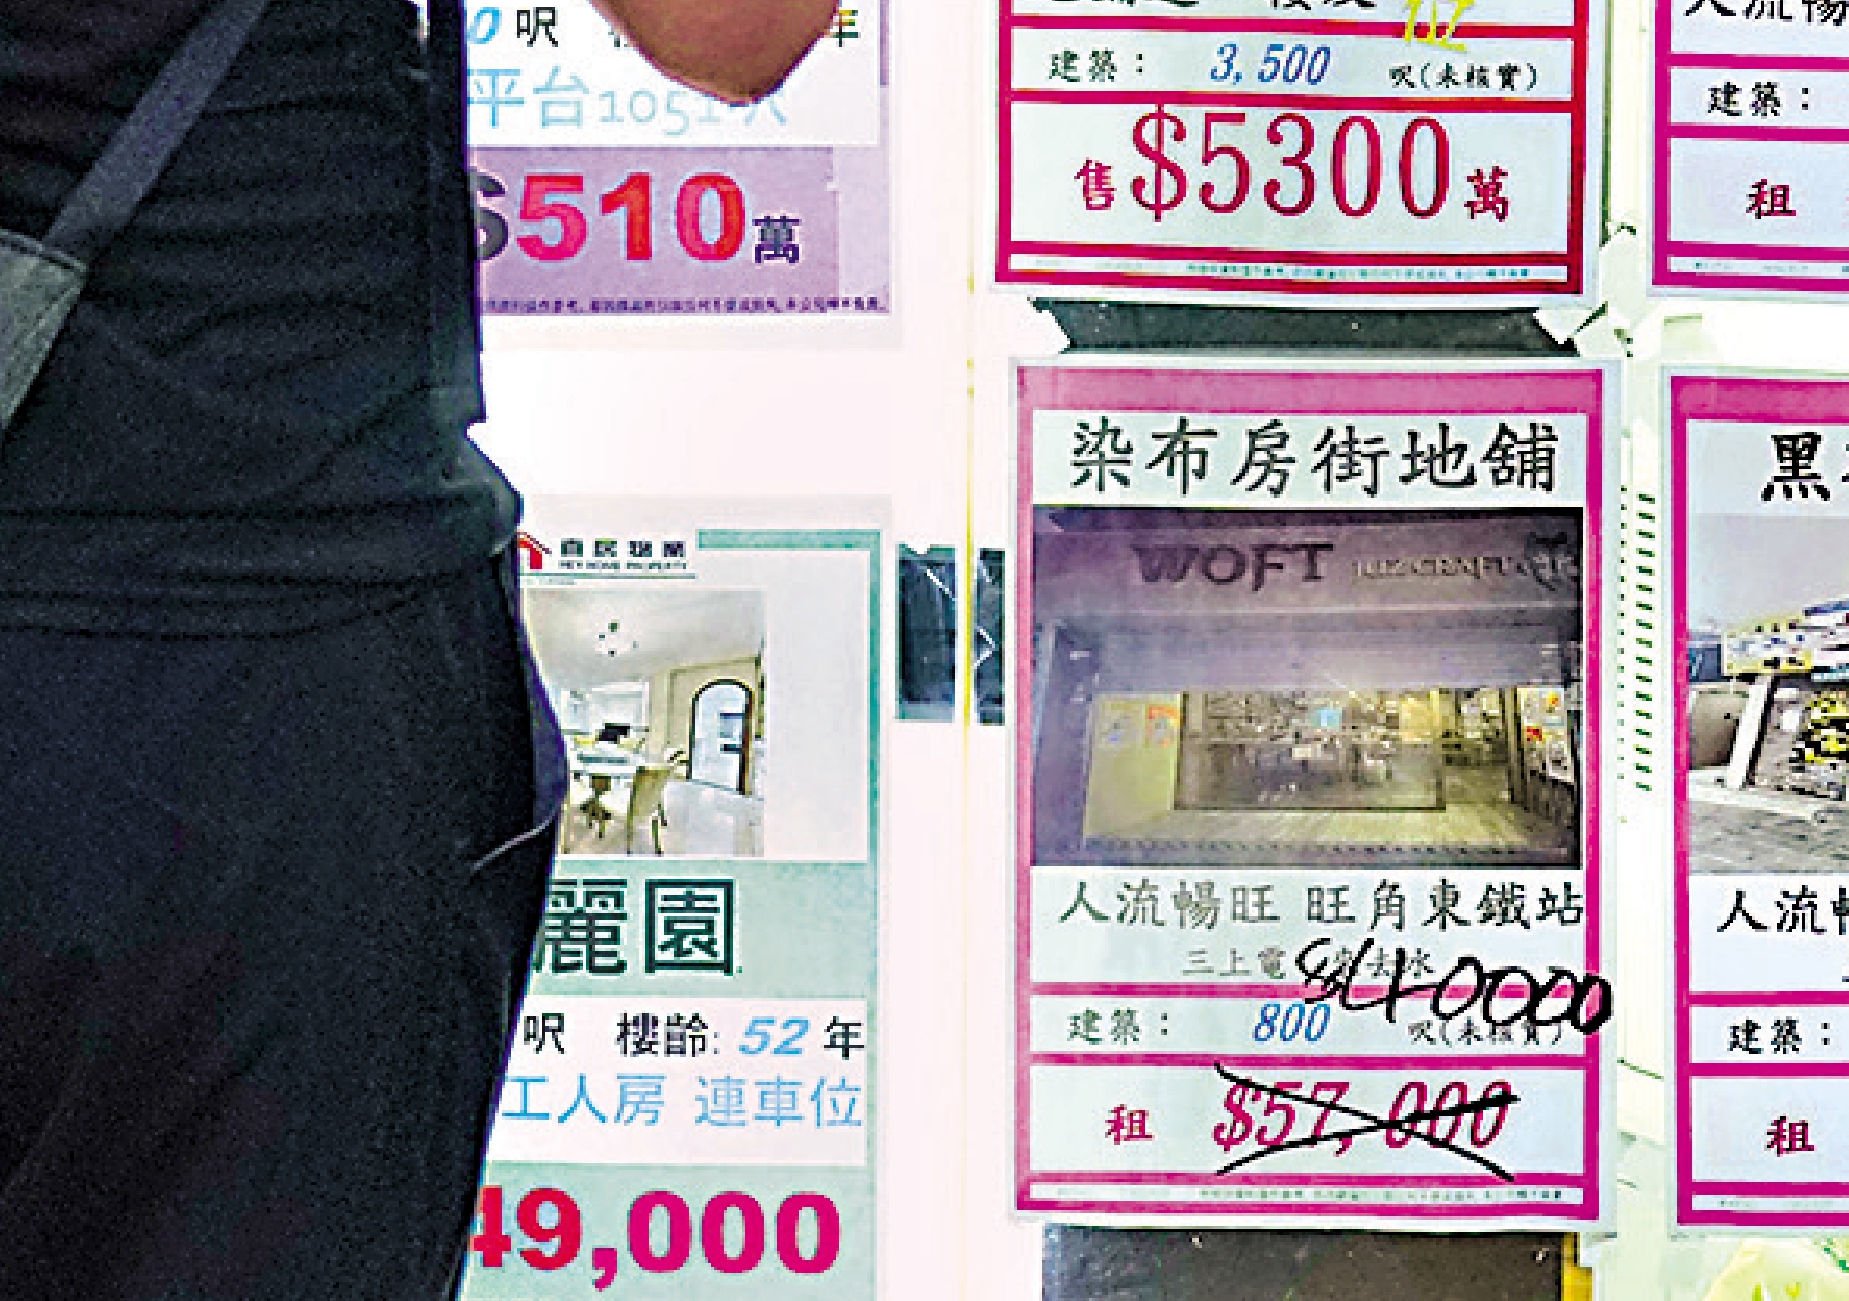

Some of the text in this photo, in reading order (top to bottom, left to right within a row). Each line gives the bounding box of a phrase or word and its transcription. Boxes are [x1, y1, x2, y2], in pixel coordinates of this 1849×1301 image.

[1210, 43, 1331, 87] 3,500
[1746, 178, 1796, 218] 租
[1069, 419, 1557, 497] 染布房街地舖
[1132, 544, 1335, 592] WOFT
[1059, 881, 1584, 932] 人流暢旺 旺角東鐵站
[738, 1016, 865, 1059] 52 年
[1253, 1003, 1332, 1043] 800
[696, 1076, 864, 1129] 連車位
[1105, 1104, 1153, 1142] 租
[1766, 1115, 1815, 1153] 租
